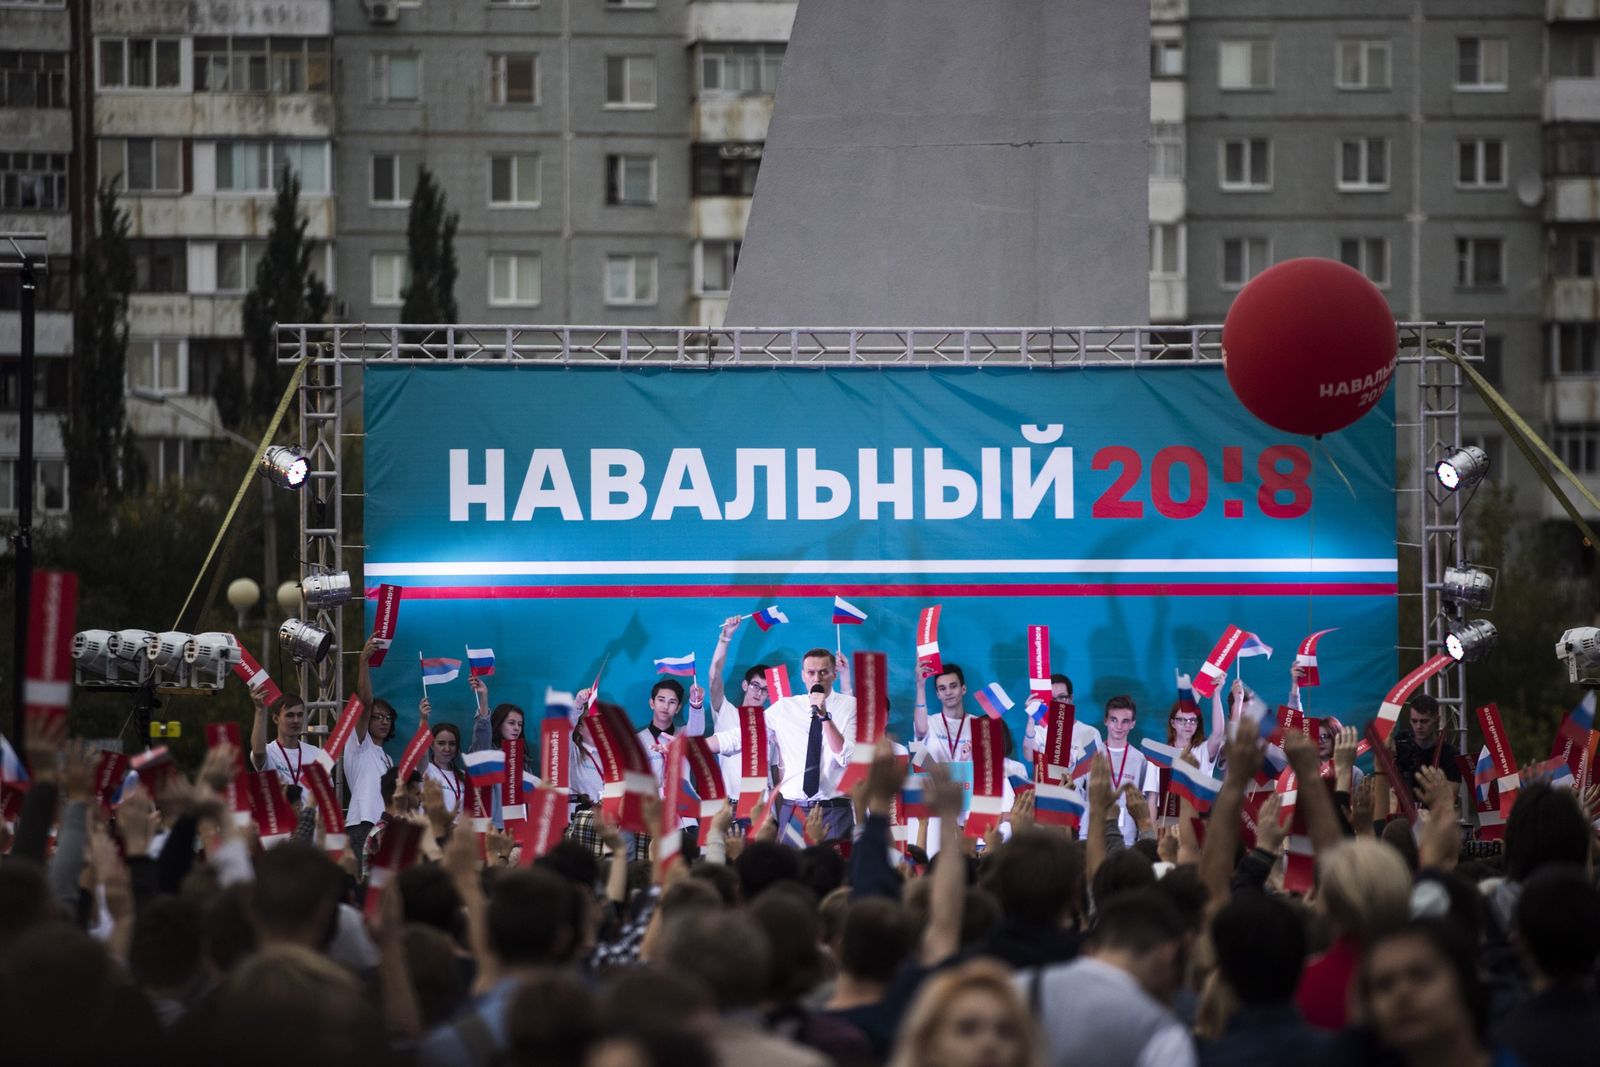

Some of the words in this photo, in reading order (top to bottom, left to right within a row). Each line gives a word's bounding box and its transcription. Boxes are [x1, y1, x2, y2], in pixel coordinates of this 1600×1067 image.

[449, 424, 1074, 522] НАВАЛЬНЫЙ
[1058, 703, 1066, 720] 20!8
[1284, 709, 1294, 727] 20!8
[1302, 719, 1310, 737] 20!8
[1484, 707, 1494, 725] 20!8
[551, 739, 560, 786] НАВАЛЬНЫЙ
[749, 724, 759, 776] НАВАЛЬНЫЙ
[1053, 720, 1064, 764] НАВАЛЬНЫЙ
[1488, 725, 1510, 775] НАВАЛЬНЫЙ
